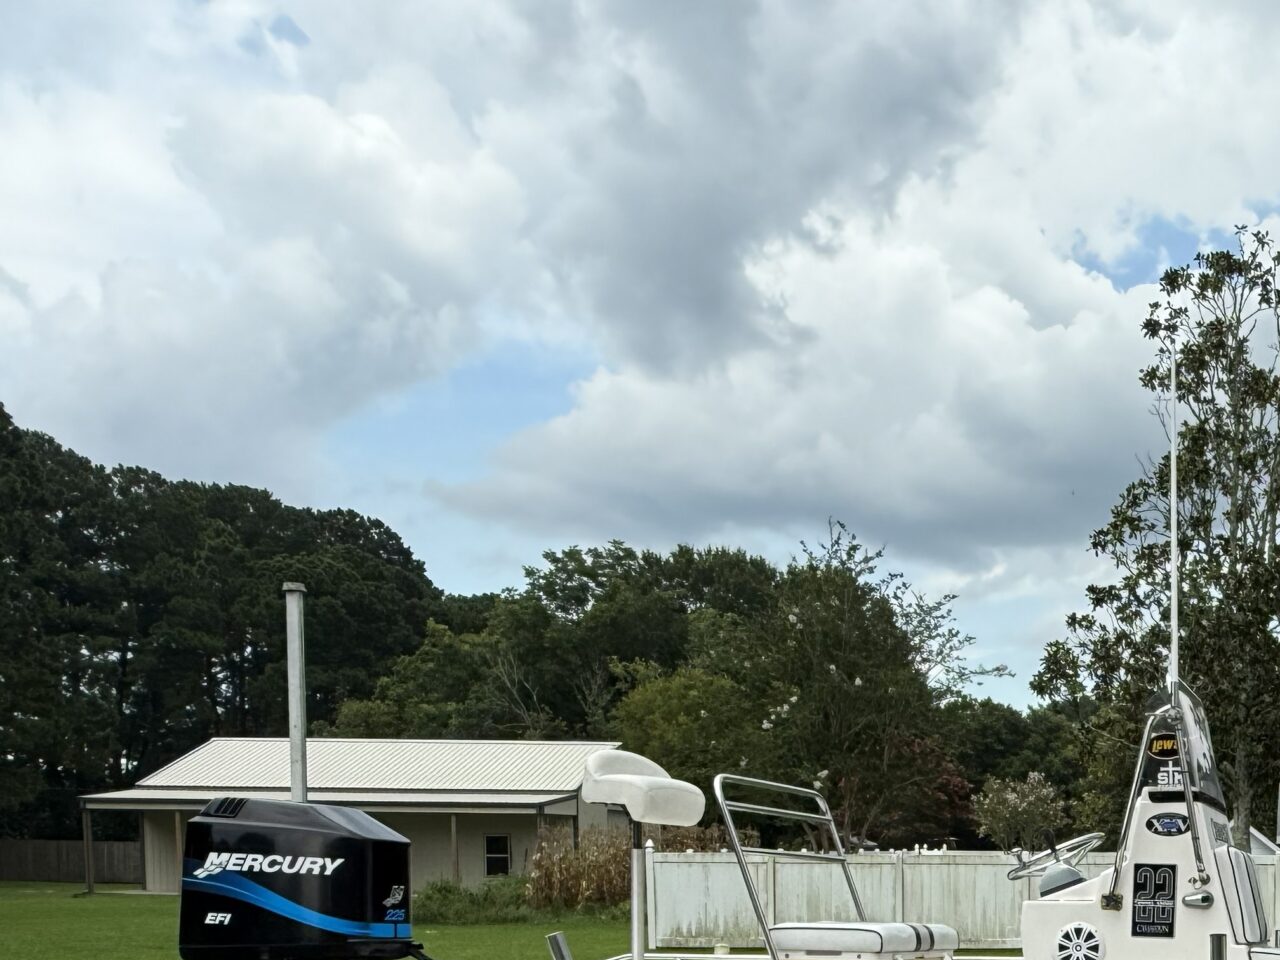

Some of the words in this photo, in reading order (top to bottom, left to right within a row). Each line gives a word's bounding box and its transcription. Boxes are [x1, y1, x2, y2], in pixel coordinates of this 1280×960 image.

[194, 852, 345, 876] MERCURY
[1136, 867, 1174, 923] 22
[204, 912, 232, 926] EFI
